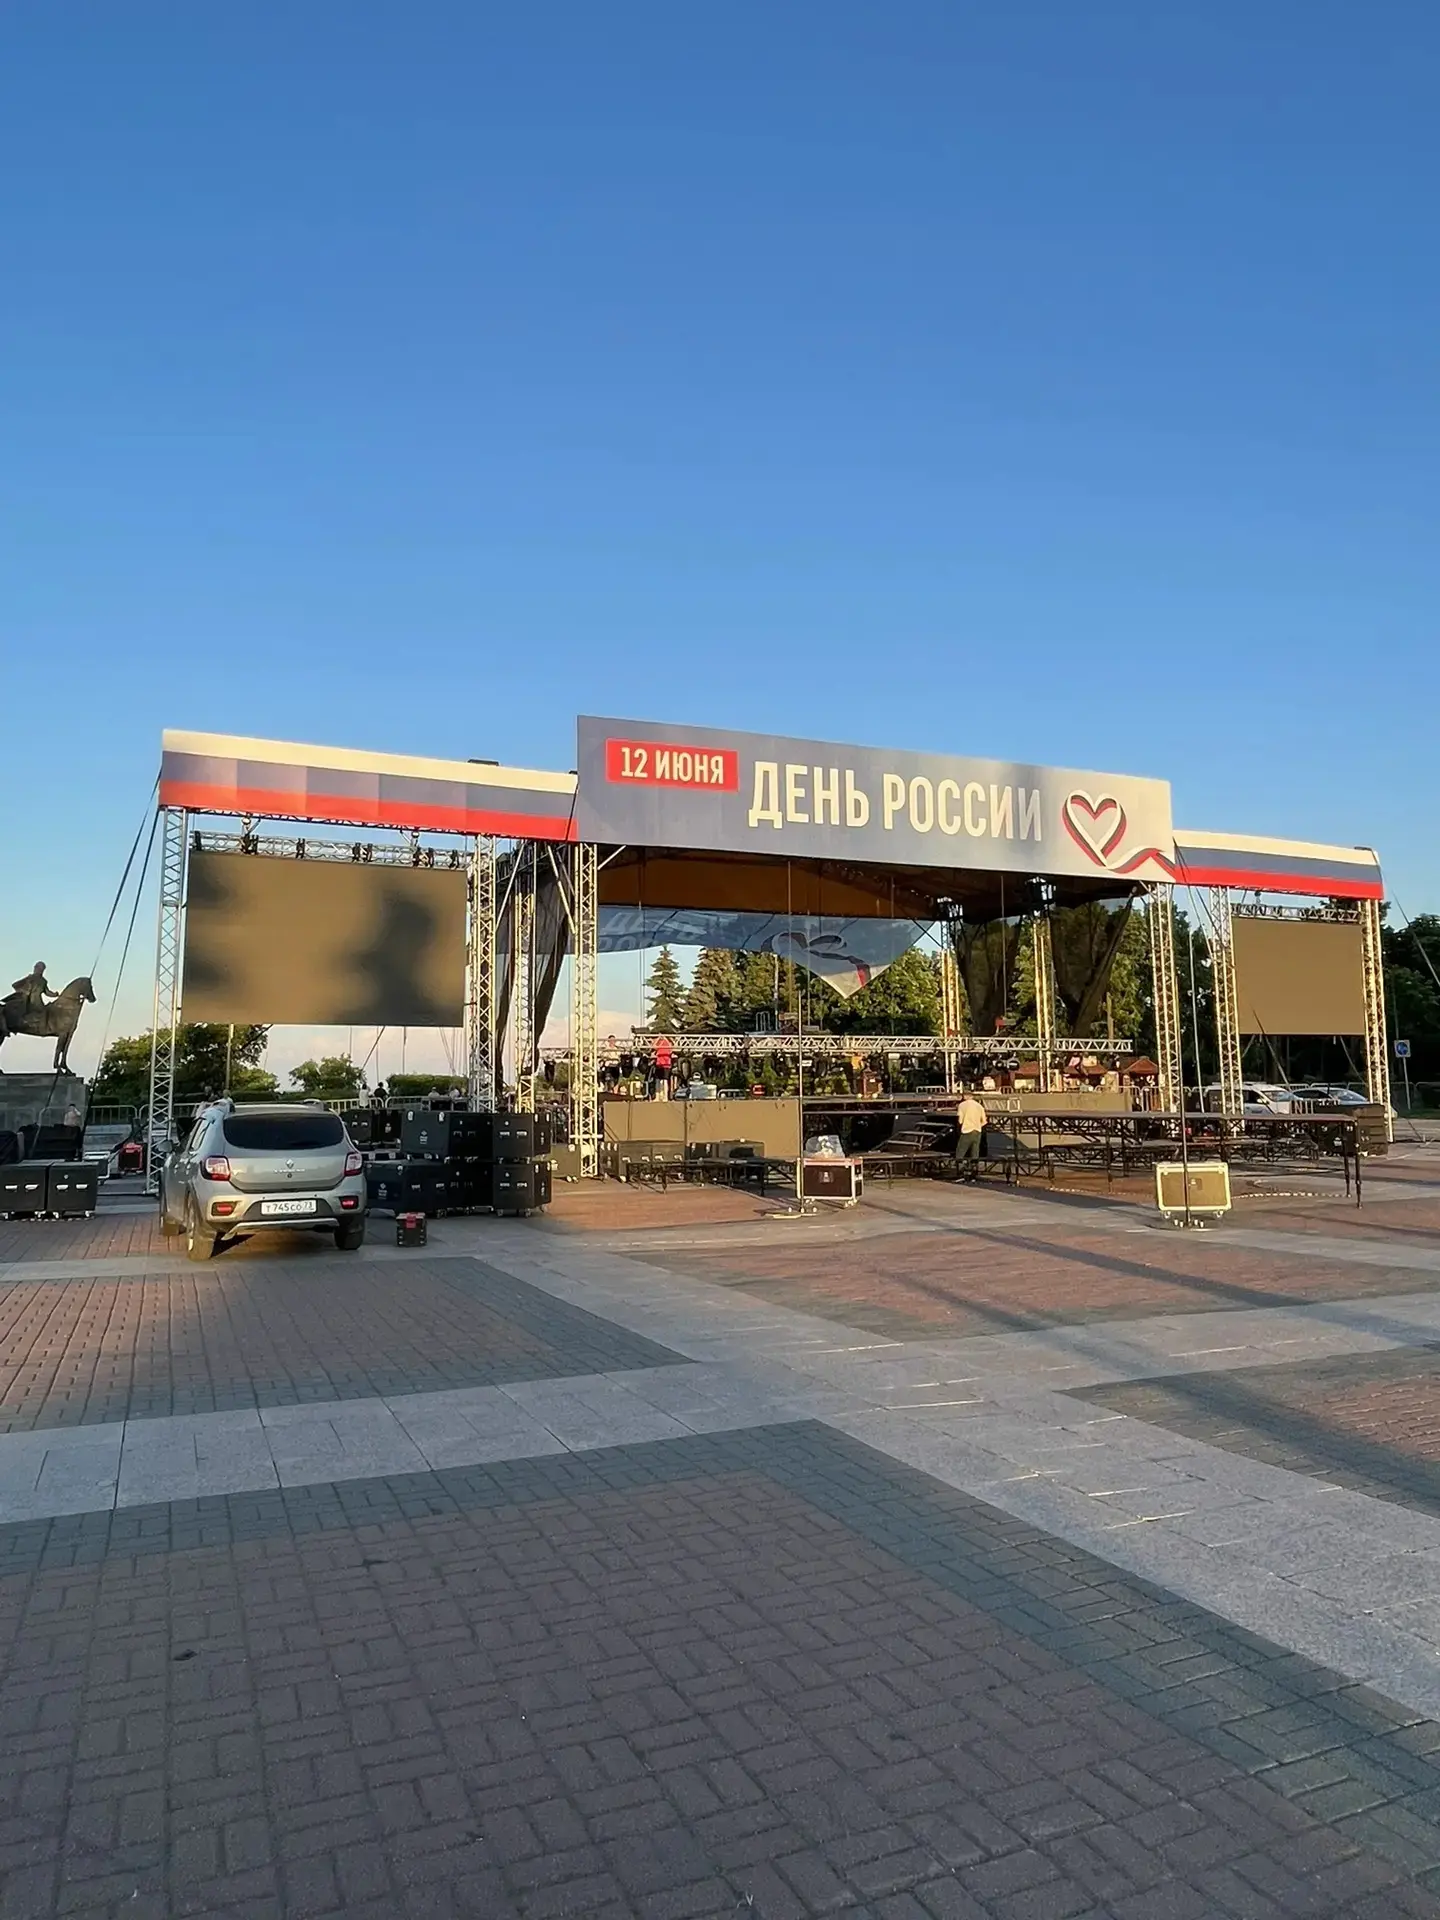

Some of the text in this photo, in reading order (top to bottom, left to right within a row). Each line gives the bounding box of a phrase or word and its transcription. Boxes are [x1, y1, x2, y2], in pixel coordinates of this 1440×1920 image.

[621, 747, 724, 784] 12 ИЮНЯ
[748, 761, 1042, 841] ДЕНЬ РОССИИ
